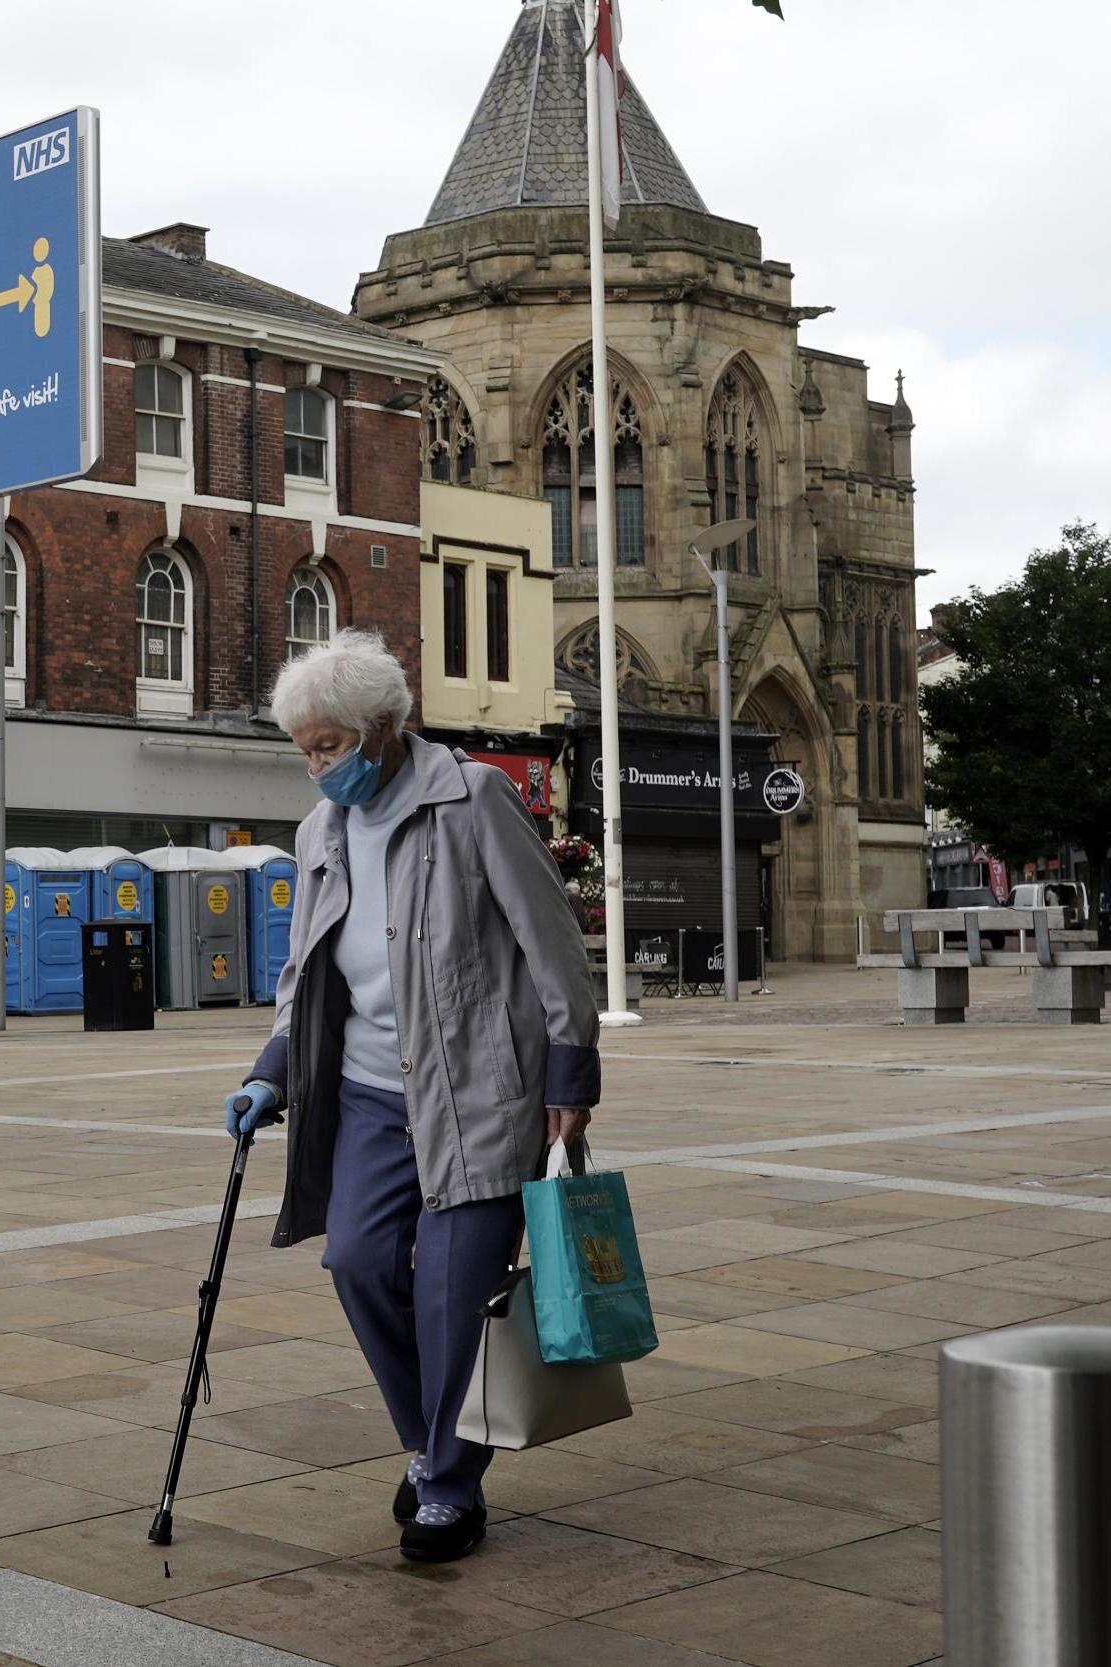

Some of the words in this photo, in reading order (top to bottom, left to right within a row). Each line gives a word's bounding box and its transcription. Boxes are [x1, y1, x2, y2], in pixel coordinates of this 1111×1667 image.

[16, 131, 67, 176] NHS
[23, 372, 58, 408] visit!
[628, 766, 702, 788] Drummer's
[634, 951, 668, 965] CARLING
